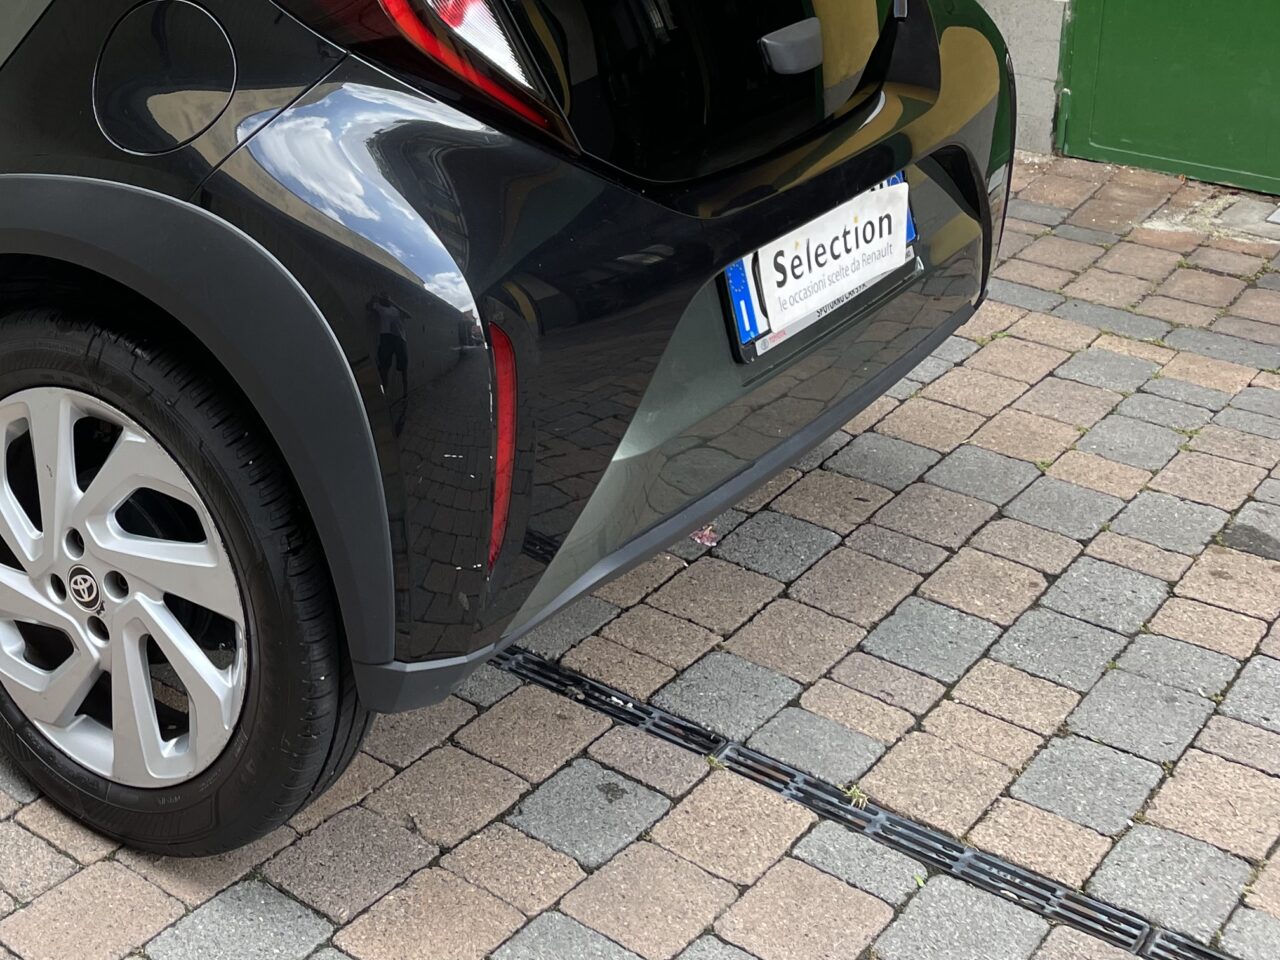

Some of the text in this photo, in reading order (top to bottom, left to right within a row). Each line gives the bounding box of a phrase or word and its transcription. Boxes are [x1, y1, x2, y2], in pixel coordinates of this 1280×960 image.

[778, 295, 788, 313] le
[788, 274, 826, 307] occasioni
[827, 265, 850, 286] scelte
[851, 256, 861, 273] da
[861, 241, 894, 267] Renault
